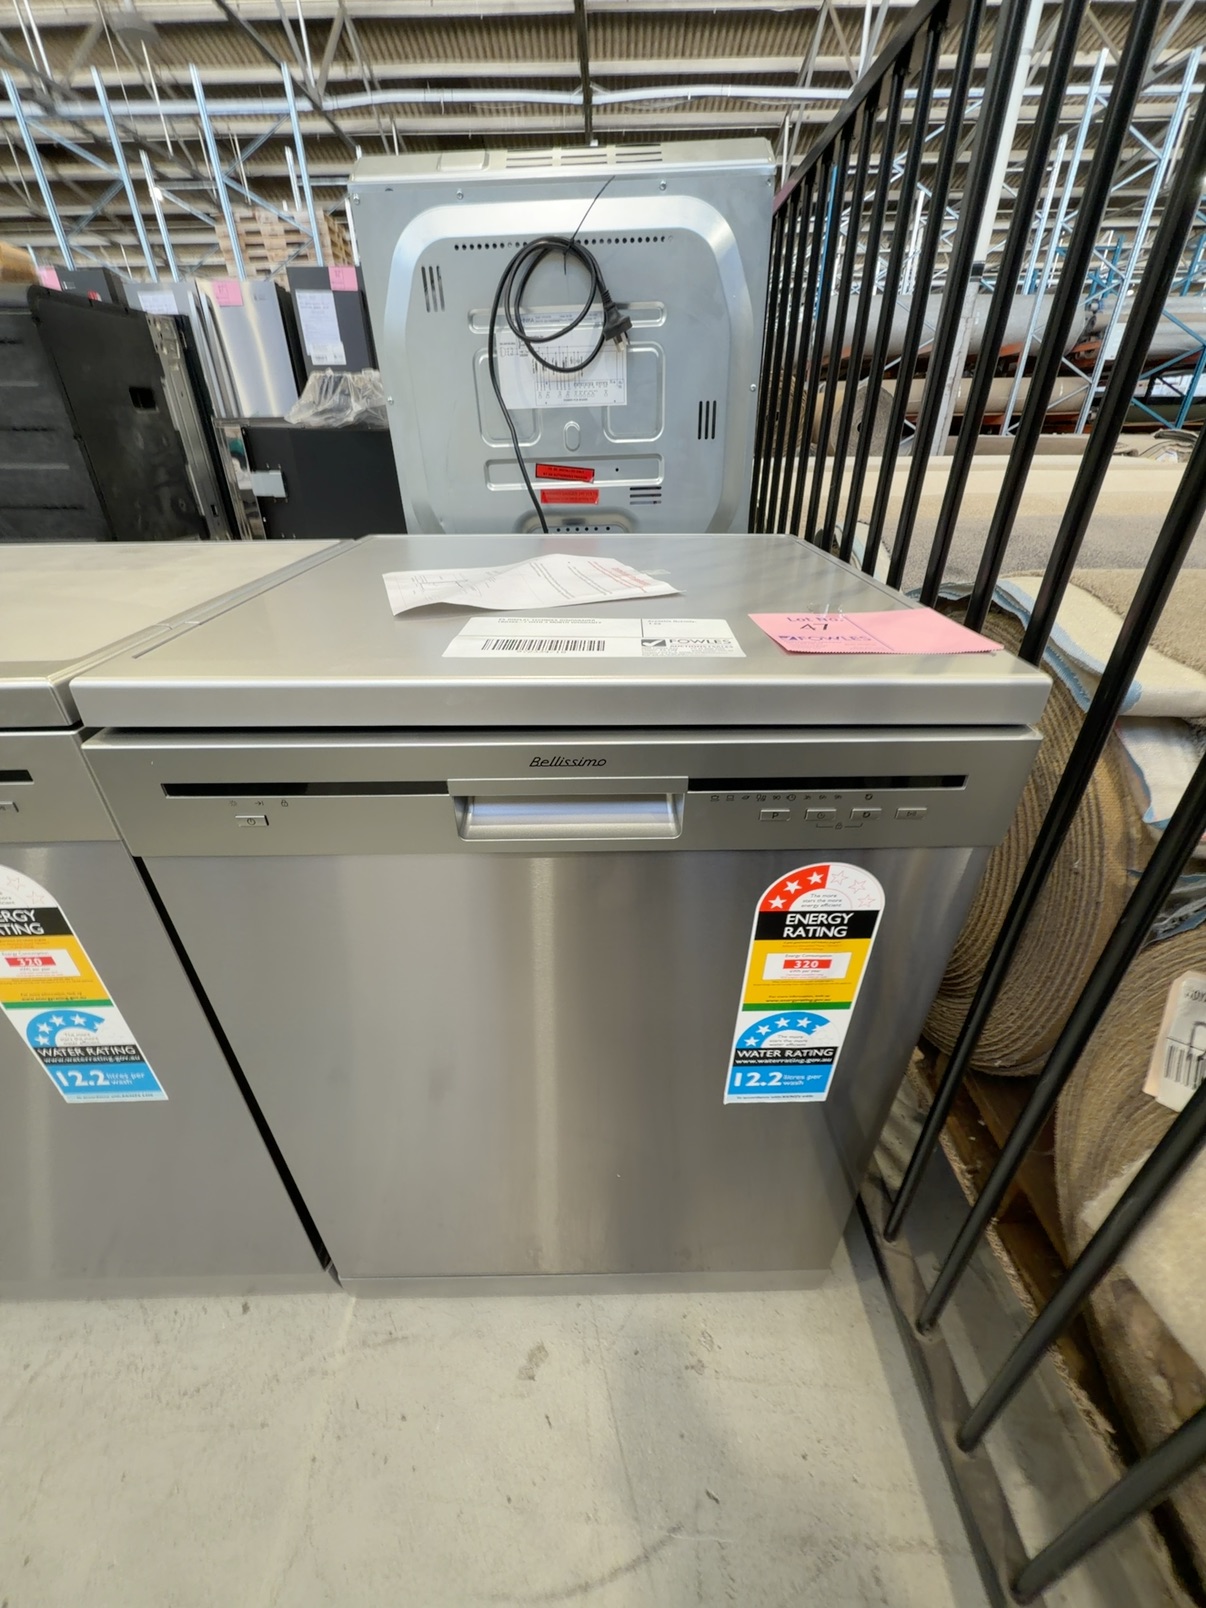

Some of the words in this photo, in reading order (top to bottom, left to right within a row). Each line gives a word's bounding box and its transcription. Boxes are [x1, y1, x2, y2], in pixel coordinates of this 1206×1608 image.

[529, 756, 607, 767] Bellissimo
[785, 912, 854, 925] ENERGY
[783, 926, 848, 938] RATING
[18, 958, 42, 967] 320
[794, 960, 819, 969] 320
[38, 1048, 84, 1057] WATER
[86, 1046, 136, 1056] RATING
[737, 1049, 781, 1058] WATER
[784, 1048, 834, 1057] RATING
[56, 1070, 110, 1087] 12.2
[734, 1071, 782, 1087] 12.2
